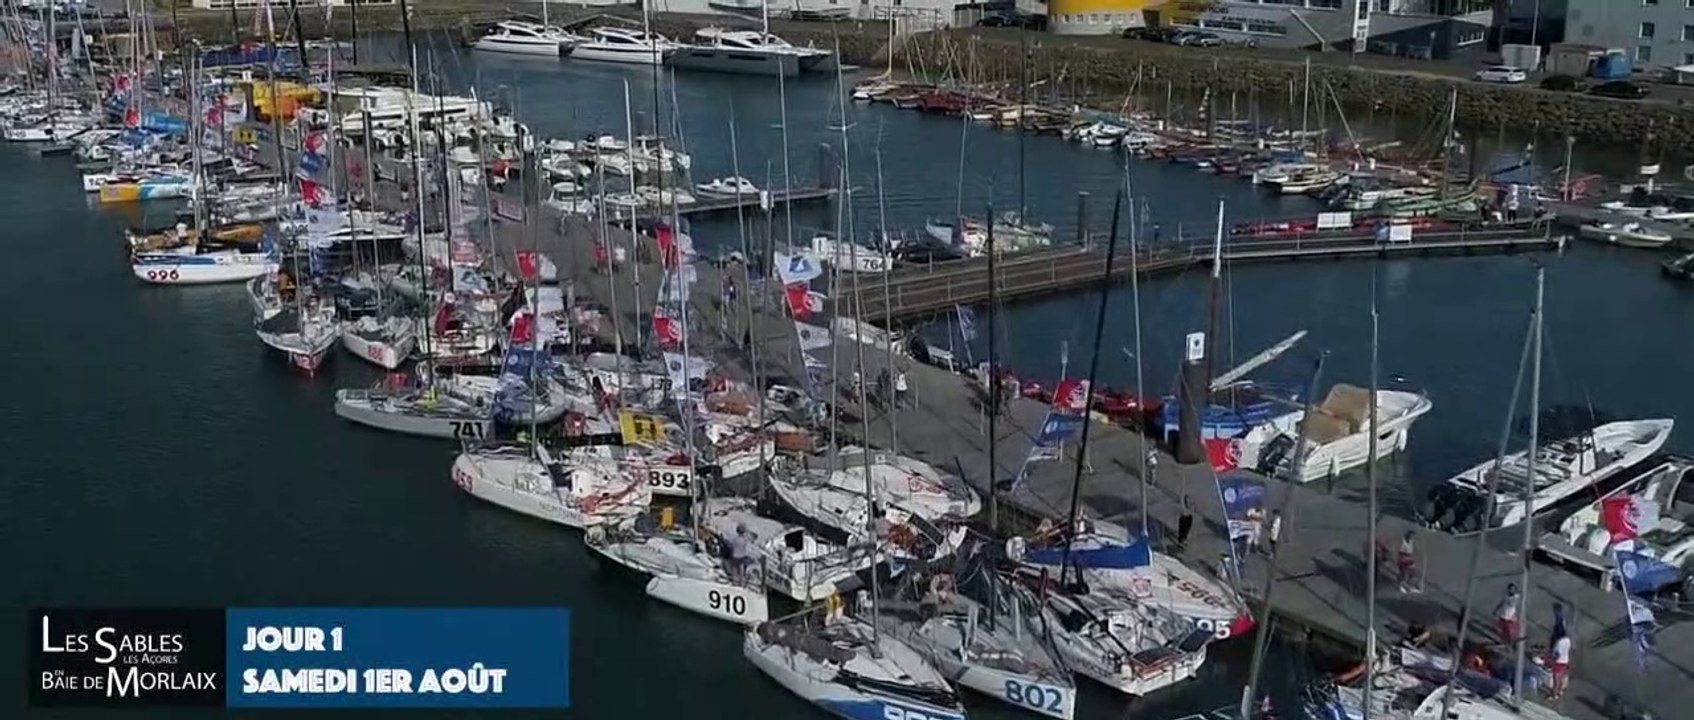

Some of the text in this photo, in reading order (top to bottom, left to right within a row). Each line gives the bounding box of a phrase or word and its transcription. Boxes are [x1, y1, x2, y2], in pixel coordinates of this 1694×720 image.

[147, 269, 179, 280] 996
[449, 421, 484, 438] 741
[649, 471, 690, 490] 893
[708, 590, 746, 616] 910
[1005, 680, 1063, 713] 802
